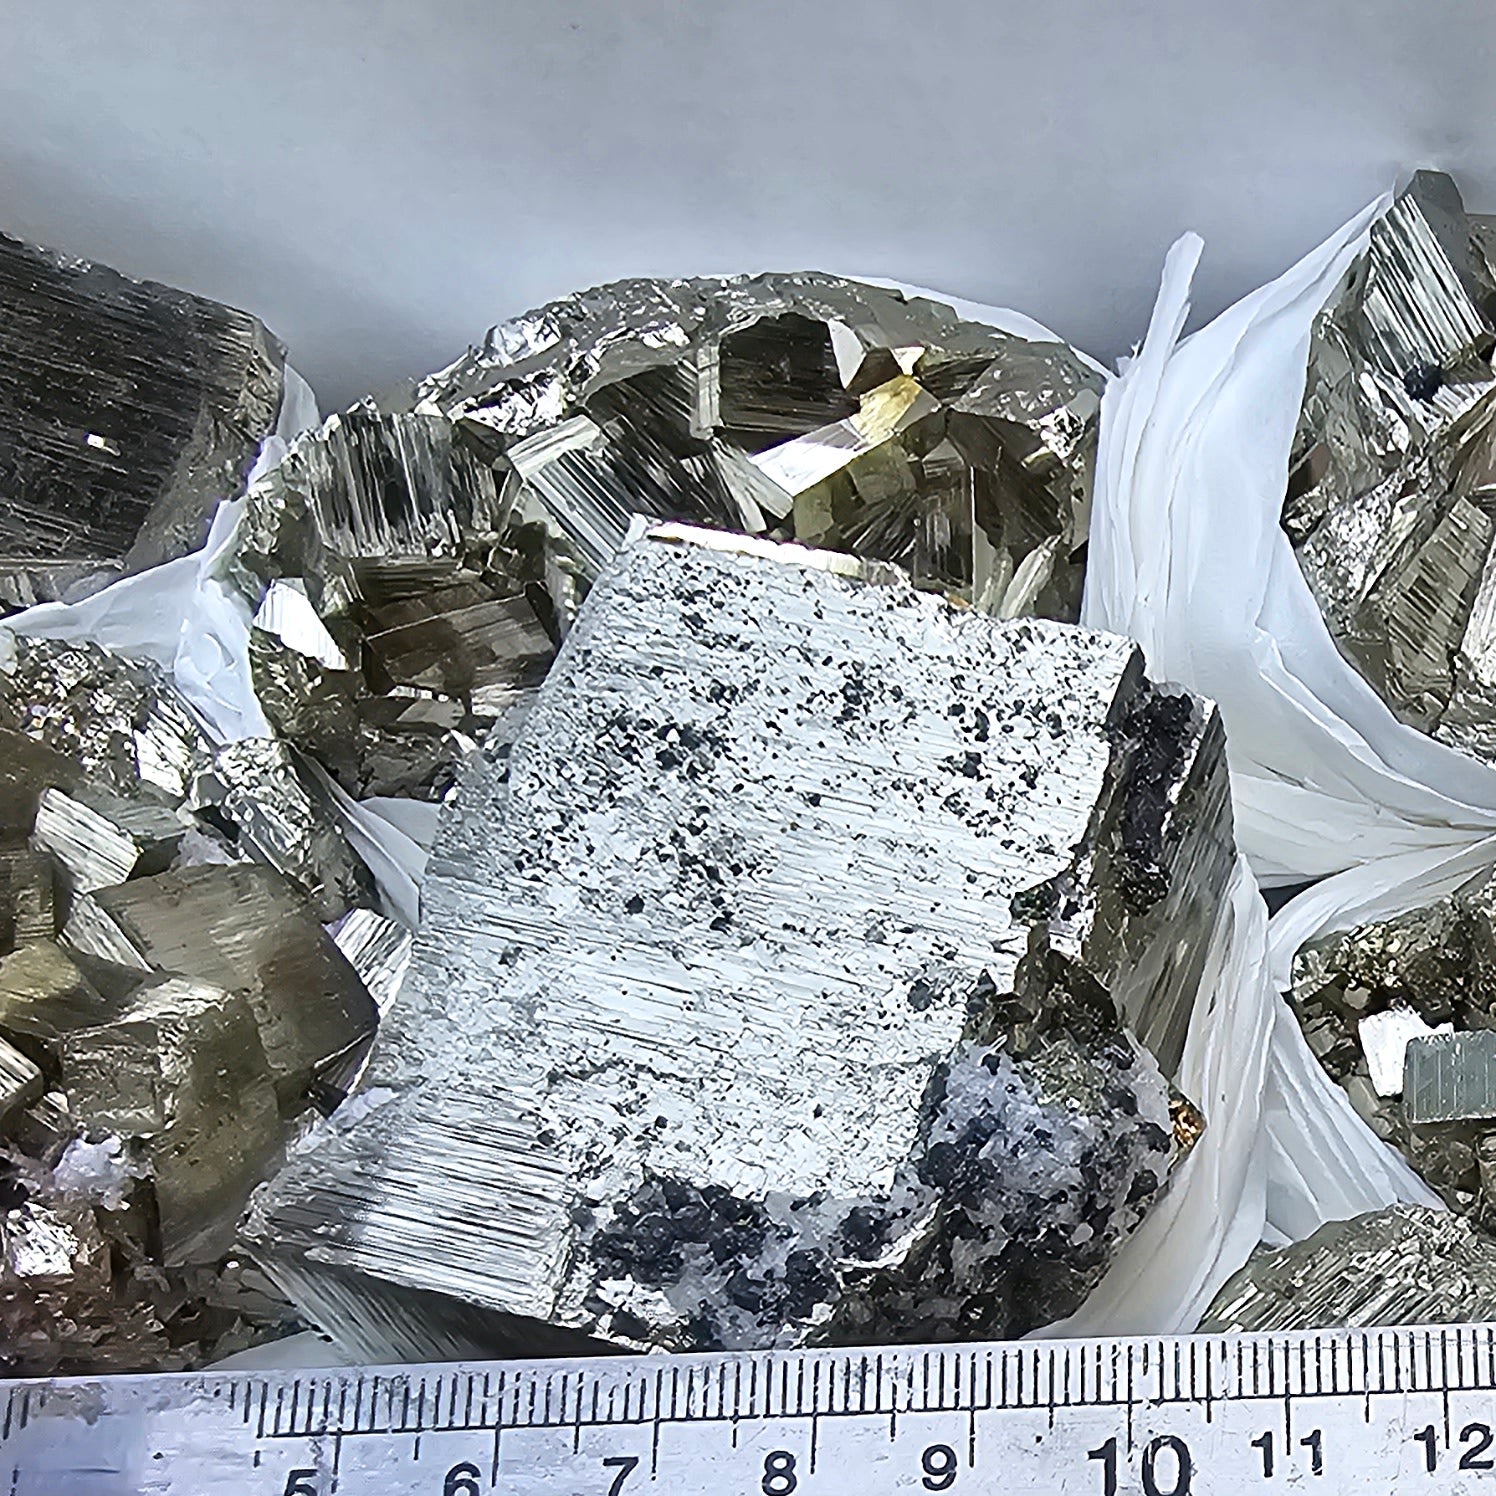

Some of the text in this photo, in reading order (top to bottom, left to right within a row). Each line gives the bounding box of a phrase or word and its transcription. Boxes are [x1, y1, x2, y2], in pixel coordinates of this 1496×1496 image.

[762, 1450, 797, 1496] 8
[921, 1444, 957, 1490] 9
[1251, 1430, 1323, 1477] 11
[1415, 1424, 1494, 1471] 12
